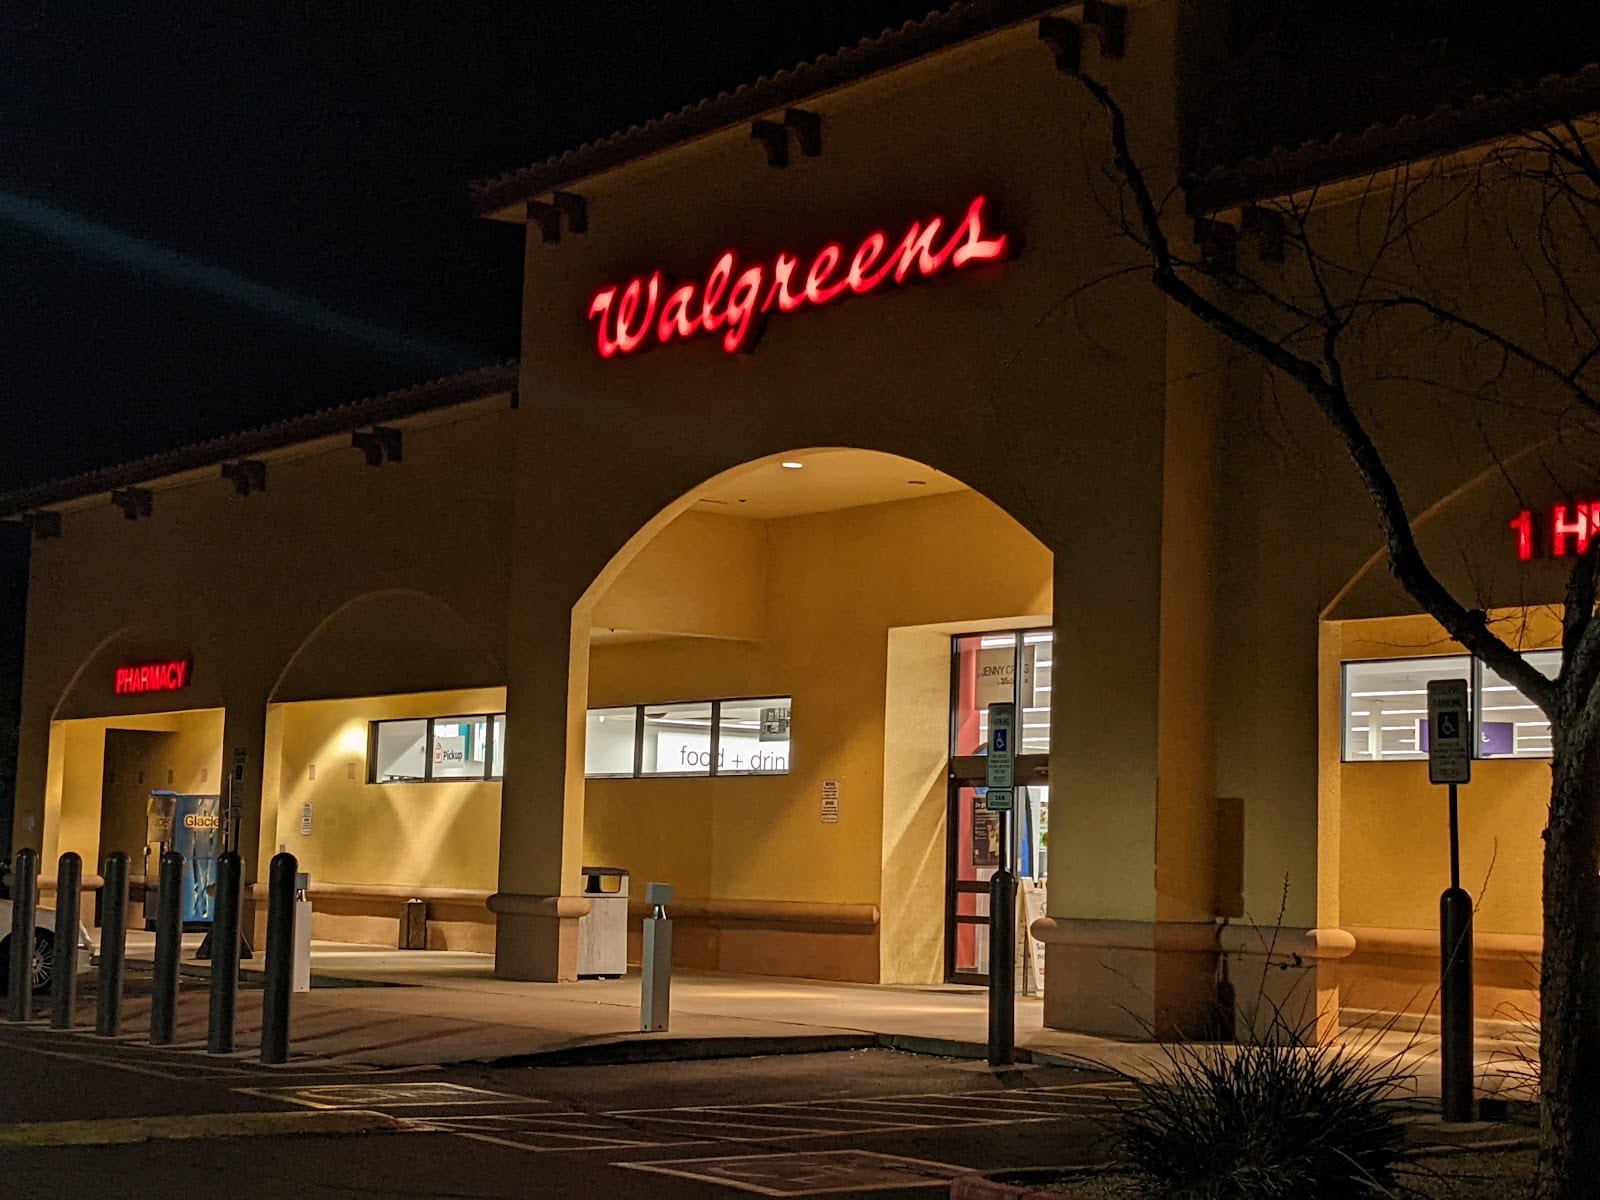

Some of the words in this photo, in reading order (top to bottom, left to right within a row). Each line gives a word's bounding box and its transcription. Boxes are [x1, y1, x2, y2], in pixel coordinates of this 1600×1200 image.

[589, 196, 1006, 357] Walgreens
[1510, 510, 1531, 560] 1
[115, 660, 187, 694] PHARMACY
[981, 664, 1006, 677] JENNY
[444, 750, 463, 762] Pickup
[681, 745, 724, 768] food
